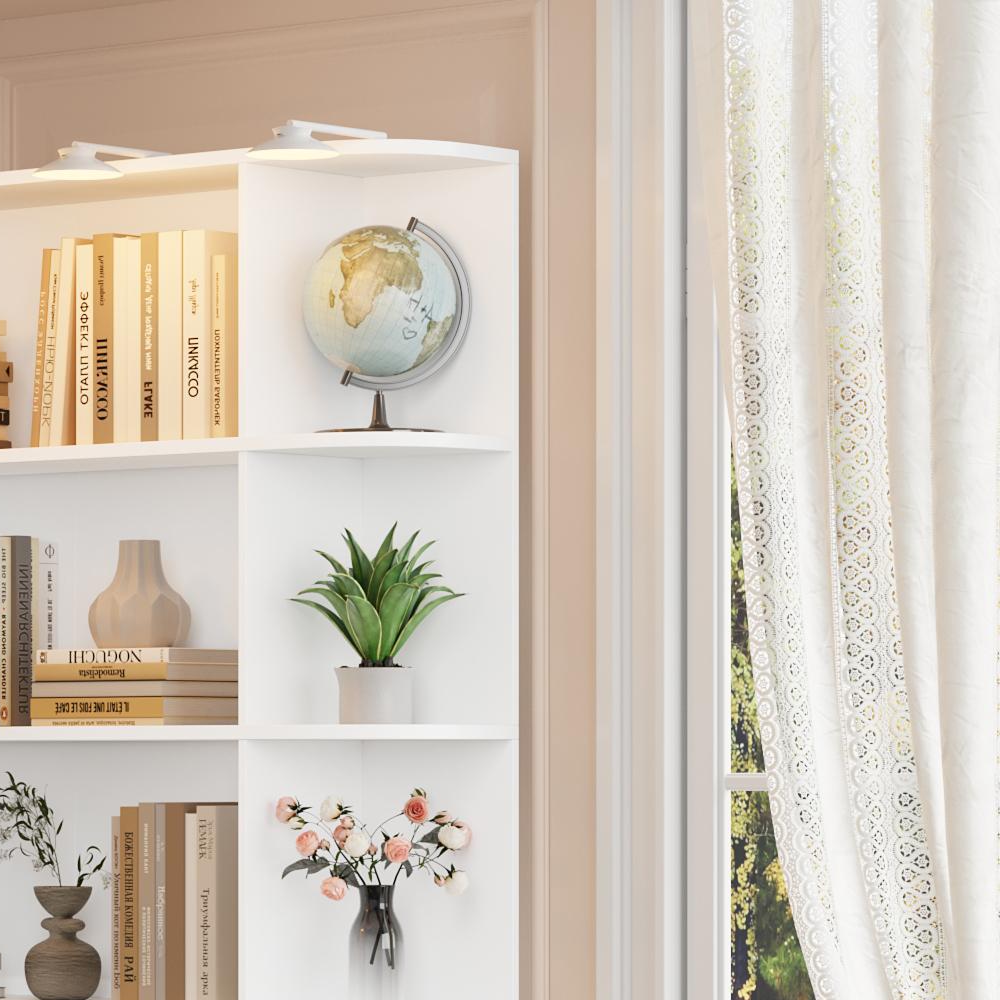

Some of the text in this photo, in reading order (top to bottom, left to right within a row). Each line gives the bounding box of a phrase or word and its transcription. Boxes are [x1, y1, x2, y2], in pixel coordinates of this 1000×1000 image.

[69, 650, 142, 663] NOGUCHI
[79, 669, 125, 678] Remodelista
[55, 702, 130, 714] IL ÉTAIT UNE FOIS LE CAFÉ
[124, 832, 136, 983] БОЖЕСТВЕННАЯ КОМЕДИЯ РАЙ
[201, 888, 210, 967] Триумфальная
